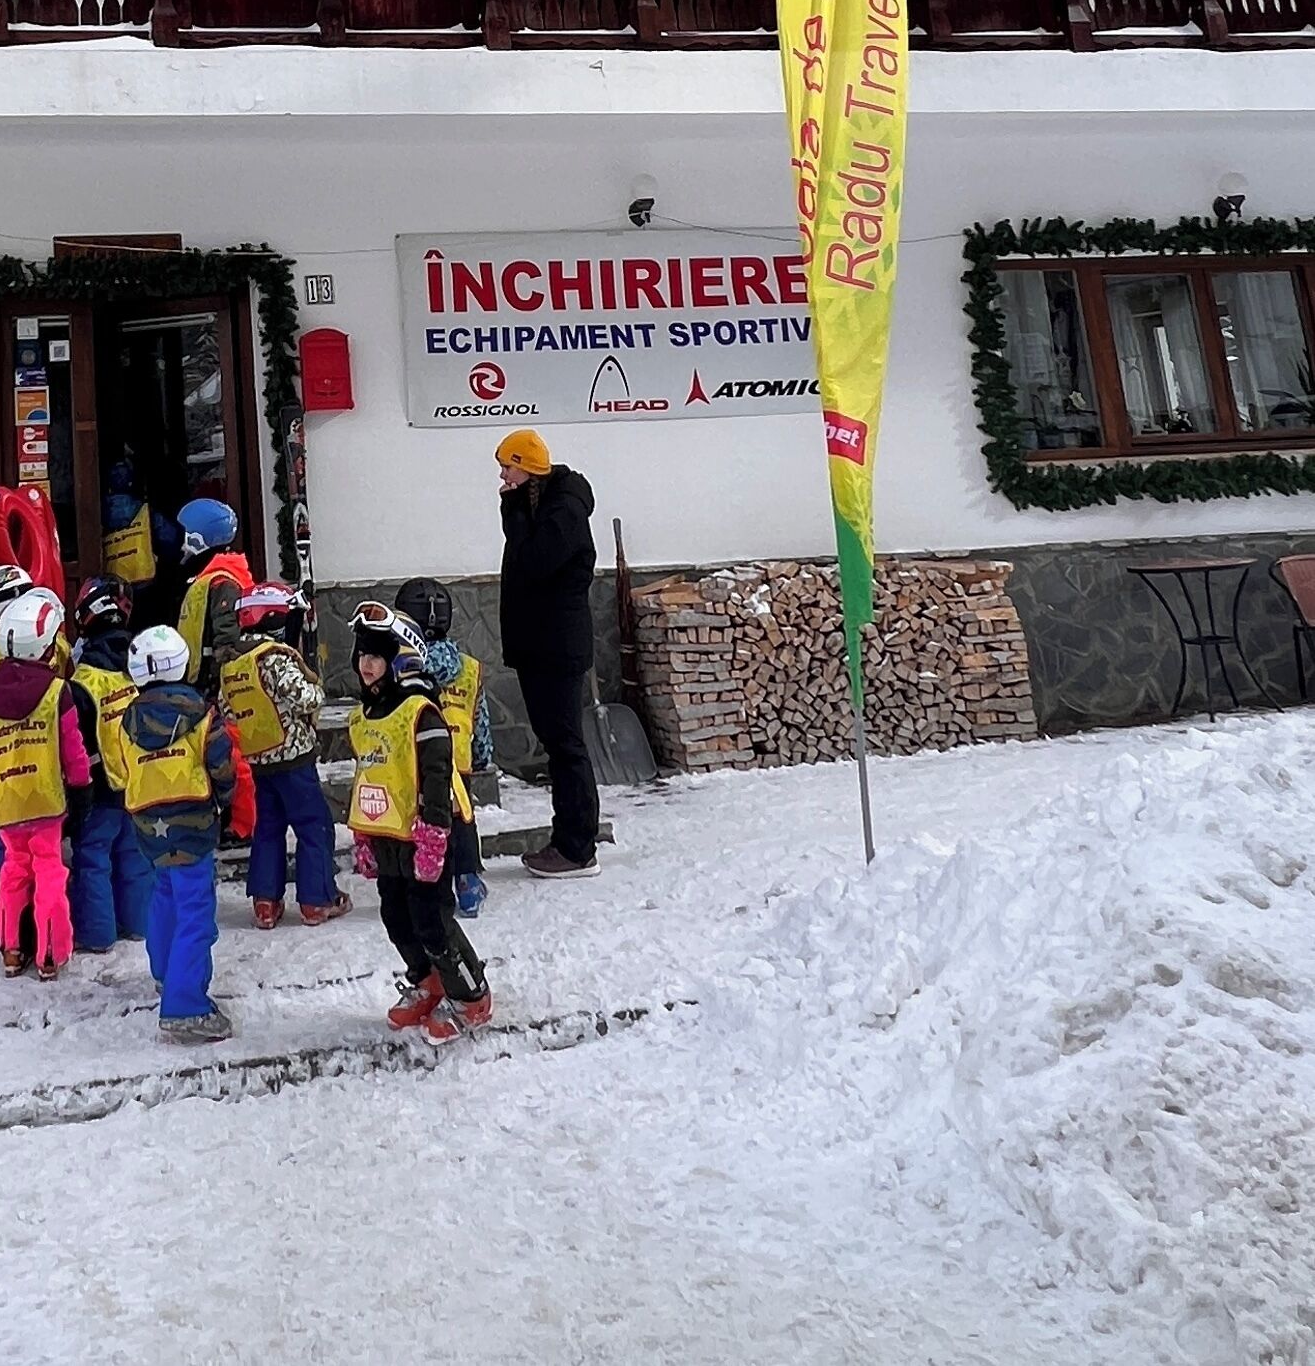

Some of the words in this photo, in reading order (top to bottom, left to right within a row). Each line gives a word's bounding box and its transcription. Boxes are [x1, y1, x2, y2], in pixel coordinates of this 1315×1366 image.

[793, 15, 826, 93] de
[825, 141, 891, 290] Radu
[308, 278, 331, 301] 13
[424, 249, 809, 313] ÎNCHIRIERE
[426, 324, 656, 354] ECHIPAMENT
[668, 316, 811, 348] SPORTIV
[433, 403, 540, 419] ROSSIGNOL
[593, 399, 669, 413] HEAD
